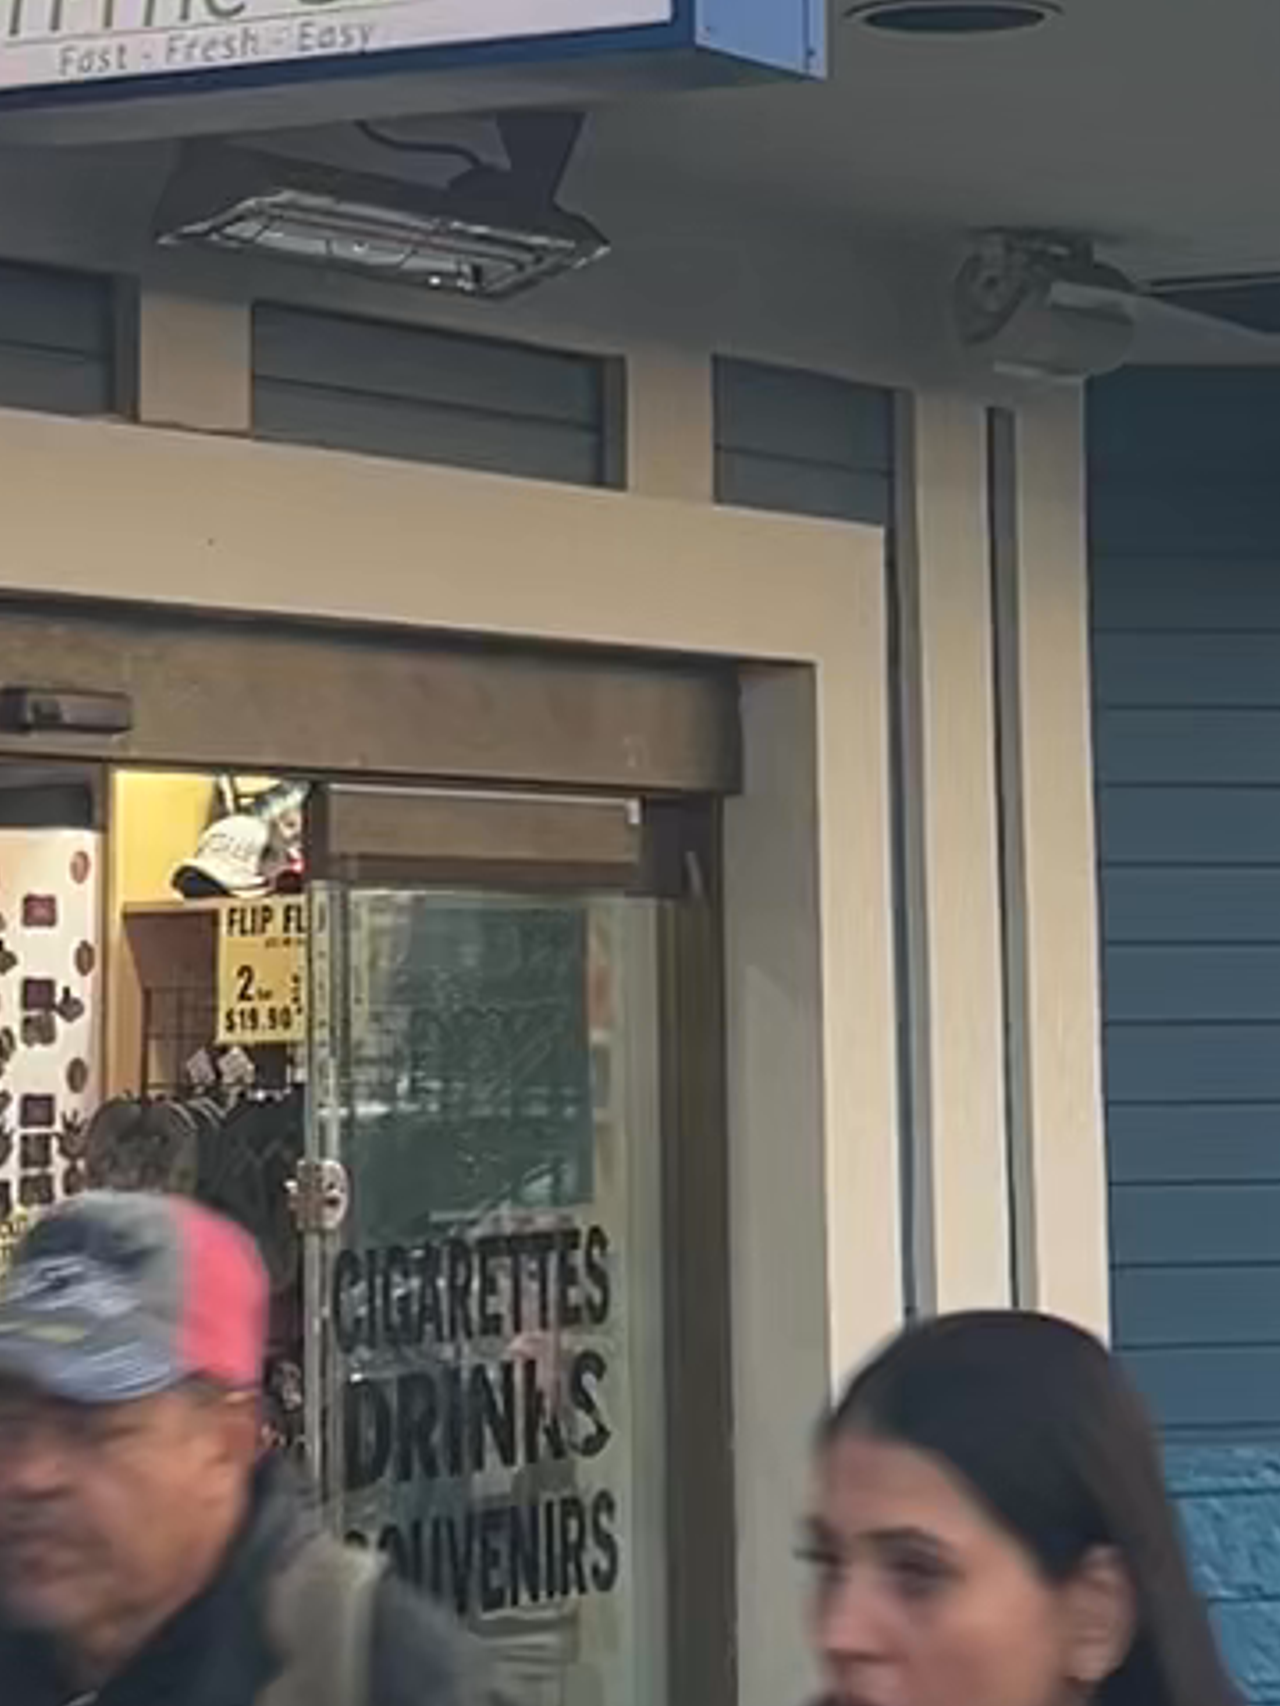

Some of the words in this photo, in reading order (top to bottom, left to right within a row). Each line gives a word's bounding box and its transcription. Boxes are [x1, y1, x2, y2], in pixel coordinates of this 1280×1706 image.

[57, 45, 129, 77] Fast
[163, 28, 260, 66] Fresh
[296, 20, 376, 57] Easy
[228, 905, 274, 936] FLIP
[237, 965, 254, 1001] 2
[332, 1225, 612, 1352] CIGARETTES
[342, 1351, 612, 1492] DRINKS
[343, 1490, 619, 1616] UVENIRS
